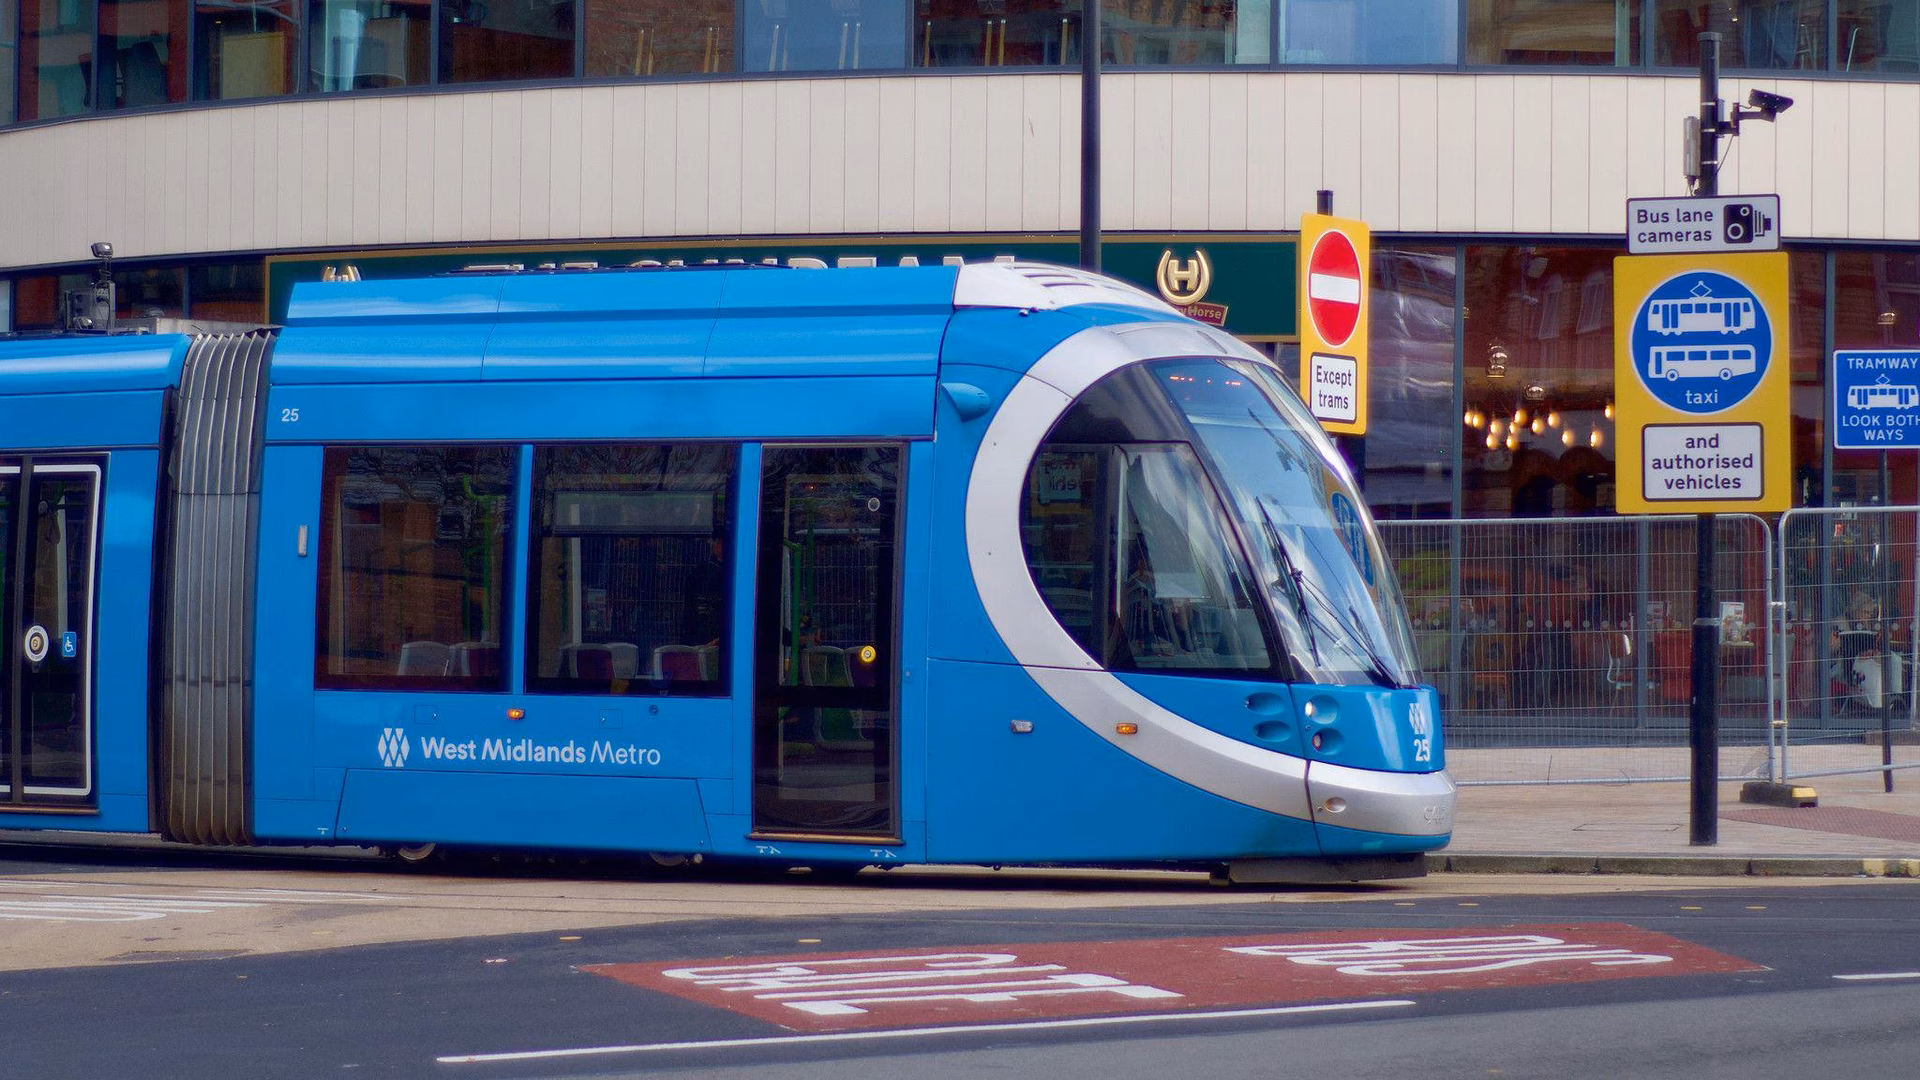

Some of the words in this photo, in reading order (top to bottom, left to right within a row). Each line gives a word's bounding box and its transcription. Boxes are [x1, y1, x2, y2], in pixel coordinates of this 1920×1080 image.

[1637, 209, 1670, 223] Bus
[1677, 208, 1713, 223] lane
[1638, 230, 1712, 243] cameras
[1188, 305, 1222, 319] Horse
[1847, 358, 1918, 369] TRAMWAY
[1316, 365, 1352, 388] Except
[1319, 390, 1349, 410] trams
[1685, 389, 1718, 404] taxi
[281, 408, 299, 422] 25
[1842, 415, 1880, 426] LOOK
[1685, 433, 1719, 448] and
[1864, 429, 1904, 441] WAYS
[1652, 453, 1753, 469] authorised
[1664, 474, 1741, 489] vehicles
[421, 736, 476, 760] West
[481, 738, 586, 764] Midlands
[590, 740, 661, 765] Metro
[1413, 738, 1431, 762] 25
